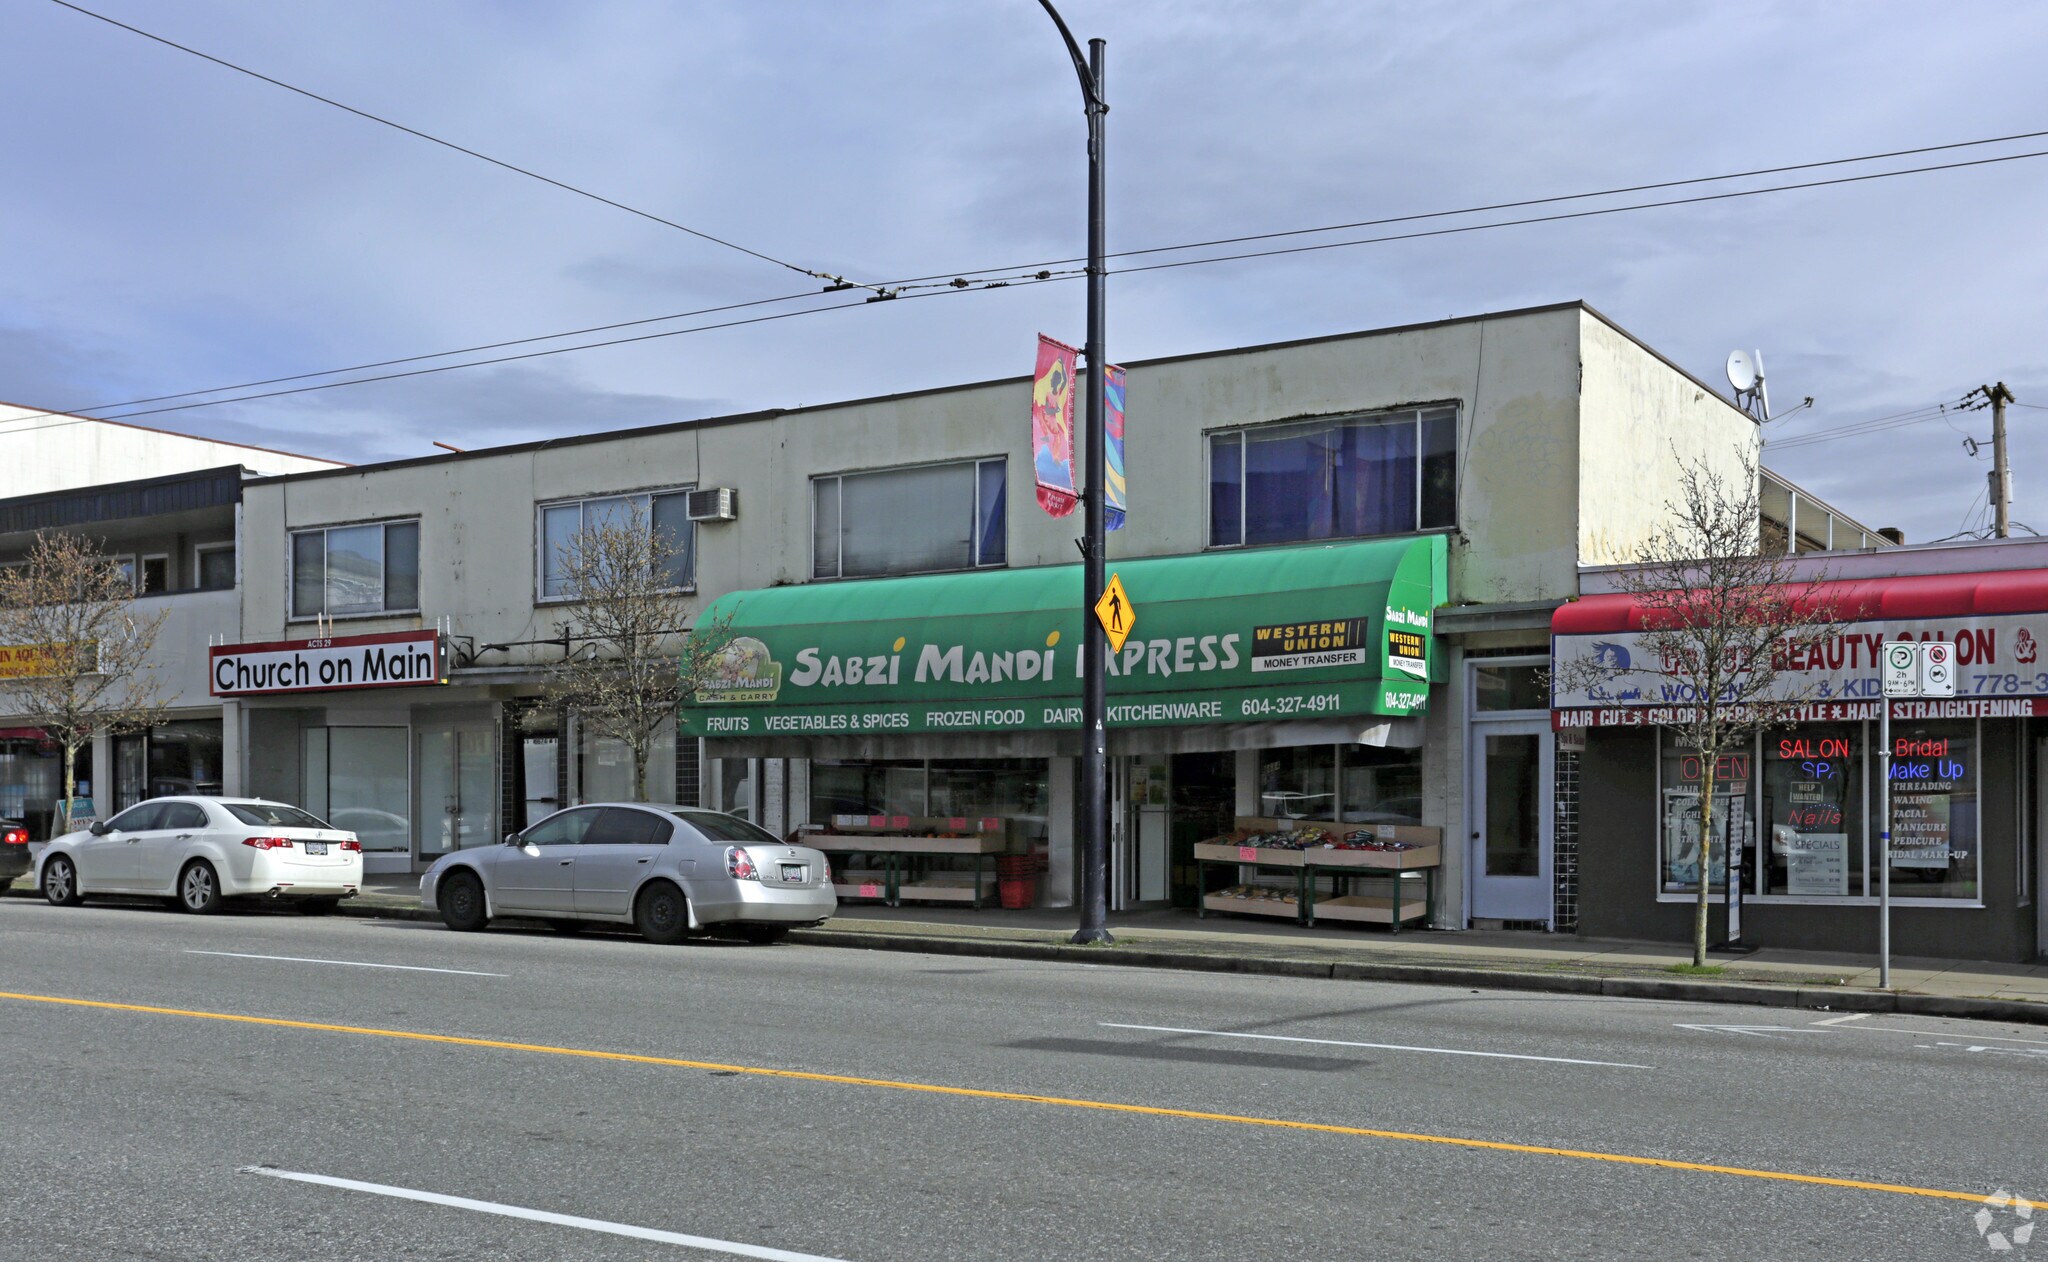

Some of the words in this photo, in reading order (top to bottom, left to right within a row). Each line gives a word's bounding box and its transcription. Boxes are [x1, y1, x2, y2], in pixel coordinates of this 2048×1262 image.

[1256, 621, 1346, 640] WESTERN
[307, 640, 322, 648] ACTS
[323, 639, 331, 647] 29
[1283, 635, 1345, 651] UNION
[1389, 632, 1419, 646] WESTERN
[1399, 645, 1419, 657] UNION
[1771, 632, 1884, 671] BEAUTY
[2013, 626, 2037, 664] &
[216, 653, 309, 690] Church
[319, 657, 352, 684] on
[362, 644, 431, 681] Main
[1263, 657, 1300, 669] MONEY
[1302, 652, 1357, 665] TRANSFER
[1393, 658, 1405, 667] MONEY
[1406, 660, 1423, 669] TRANSFER
[1817, 681, 1833, 698] &
[1843, 677, 1882, 697] KID
[699, 693, 726, 702] CASH
[740, 693, 775, 701] CARRY
[1385, 691, 1426, 710] 604-327-4911
[707, 717, 749, 731] FRUITS
[764, 714, 847, 730] VEGETABLES
[850, 714, 860, 729] &
[862, 713, 909, 729] SPICES
[926, 711, 981, 726] FROZEN
[985, 709, 1025, 725] FOOD
[1044, 707, 1084, 723] DAIRY
[1107, 701, 1222, 722] KITCHENWARE
[1241, 694, 1340, 715] 604-327-4911
[1559, 708, 1594, 727] HAIR
[1600, 708, 1631, 726] CUT
[1648, 706, 1697, 724] COLOR
[1893, 699, 2034, 720] STRAIGHTENING
[1779, 739, 1849, 759] SALON
[1895, 738, 1948, 757] Bridal
[1683, 757, 1747, 779] OEN
[1888, 761, 1930, 779] Make
[1938, 759, 1964, 780] Up
[1676, 785, 1699, 793] HAIR
[1893, 782, 1952, 791] THREADING
[1792, 793, 1820, 801] WANTED
[1893, 796, 1933, 804] WAXING
[1787, 809, 1842, 825] Nails
[1893, 809, 1928, 818] FACIAL
[1893, 823, 1947, 832] MANICURE
[1795, 840, 1840, 849] SPECIALS
[1893, 837, 1942, 845] PEDICURE
[1888, 850, 1916, 859] RIDAL
[1919, 850, 1968, 859] MAKE-UP
